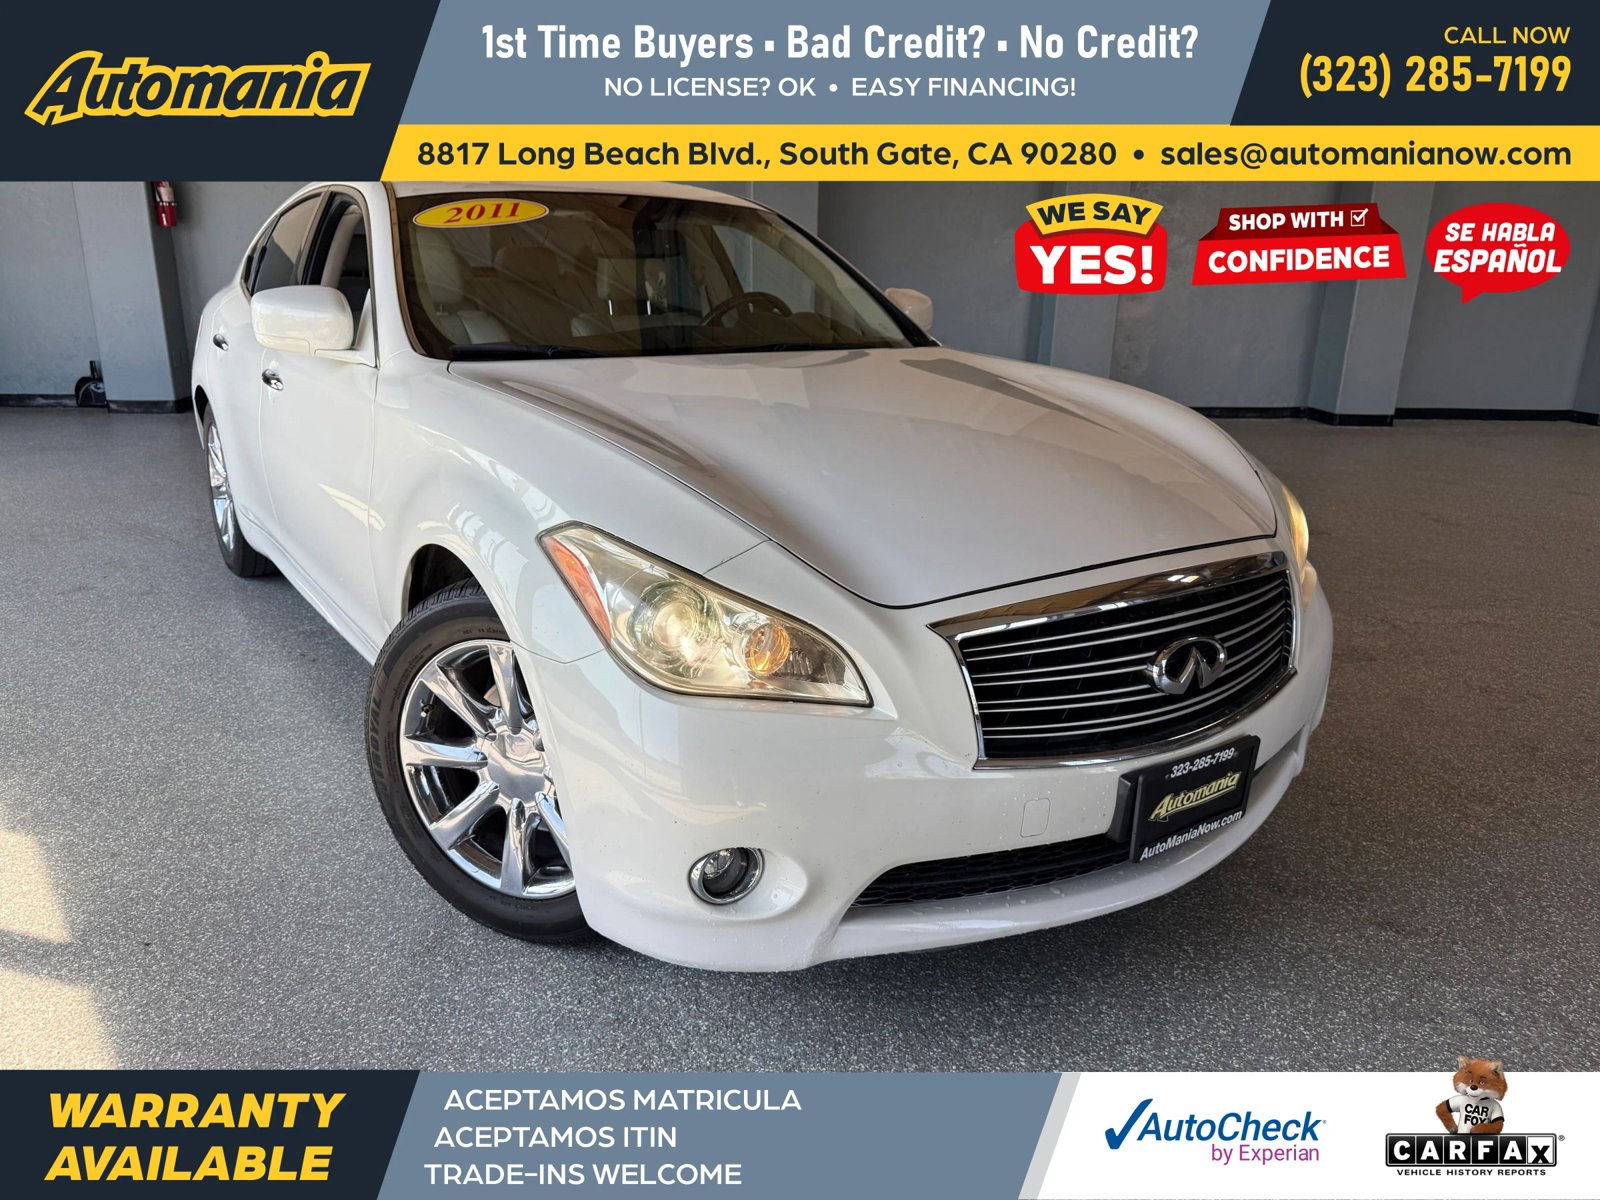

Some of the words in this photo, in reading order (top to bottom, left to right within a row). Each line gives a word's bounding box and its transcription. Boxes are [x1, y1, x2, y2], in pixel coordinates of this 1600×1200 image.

[444, 201, 521, 225] 2011
[1170, 747, 1235, 778] 323-285-7199
[1149, 772, 1241, 821] Automania
[1140, 811, 1243, 861] AutoManiaNow.com
